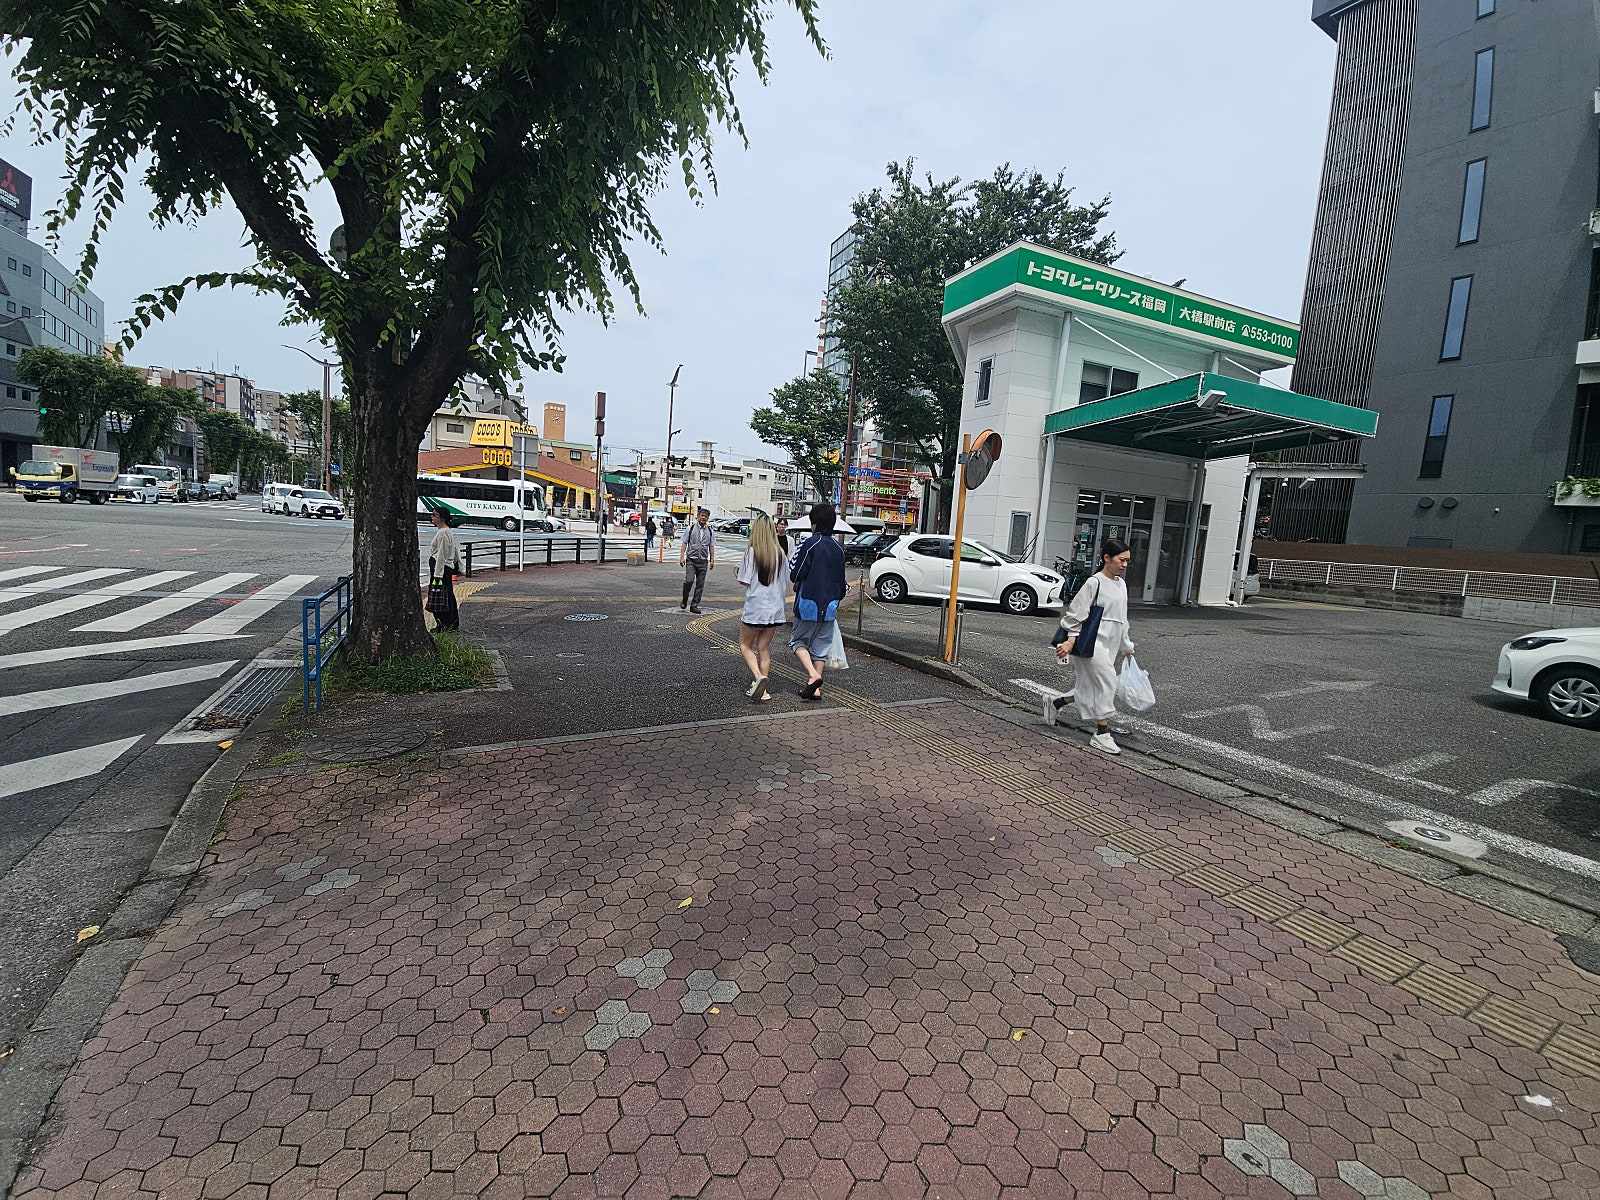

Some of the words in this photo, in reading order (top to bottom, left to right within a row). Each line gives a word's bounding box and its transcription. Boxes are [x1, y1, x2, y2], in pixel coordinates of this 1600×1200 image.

[1026, 260, 1167, 314] トヨタレンタリース福岡
[1178, 306, 1237, 334] 大橋駅前店
[1249, 326, 1293, 349] 553-0100
[477, 423, 501, 436] COCO'S
[483, 503, 507, 511] KANKO
